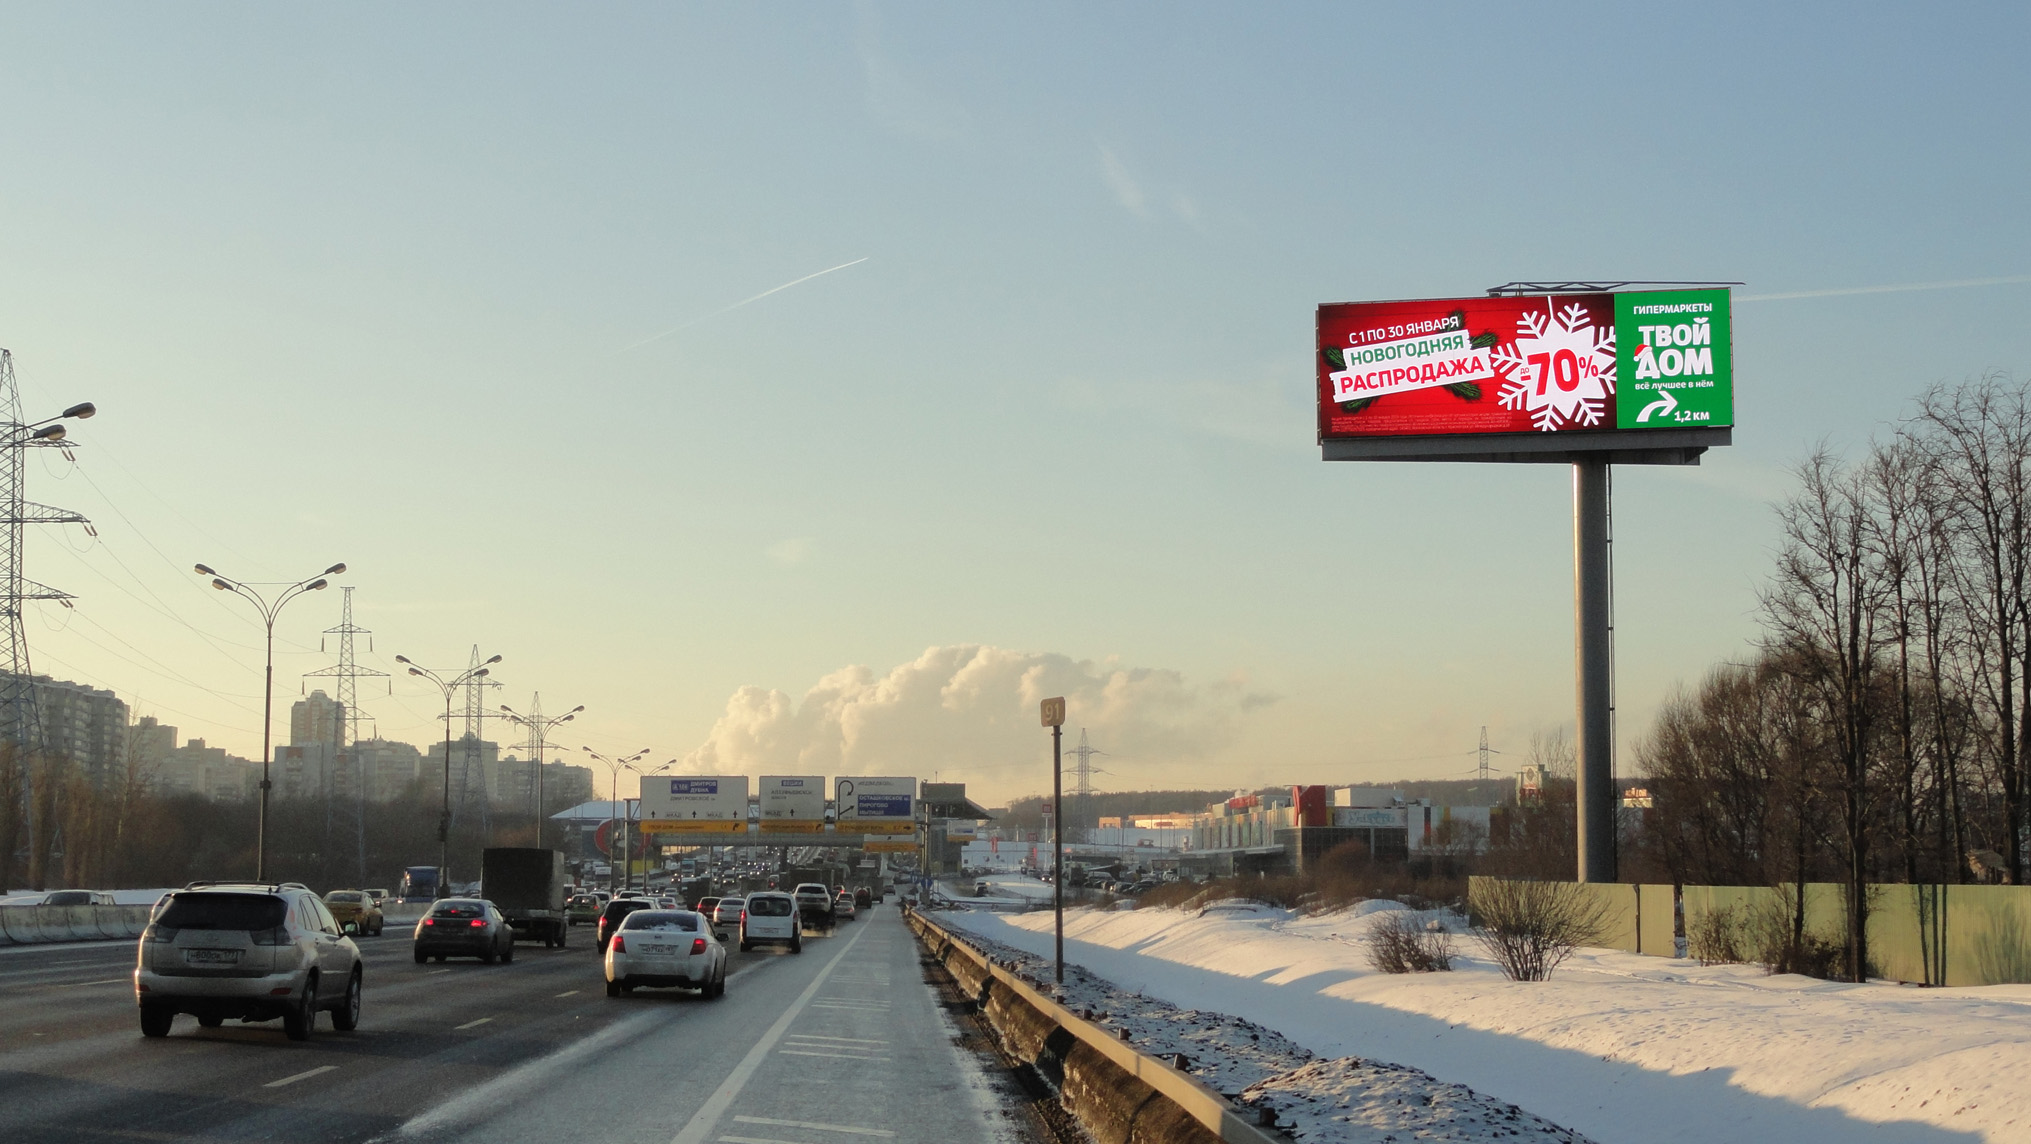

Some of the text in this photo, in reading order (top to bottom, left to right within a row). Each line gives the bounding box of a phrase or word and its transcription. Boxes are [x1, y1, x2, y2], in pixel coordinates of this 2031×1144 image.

[1633, 303, 1712, 314] ГИПЕРМАРКЕТЫ
[1349, 316, 1459, 345] С 1 ПО 30 ЯНВАРЯ
[1638, 317, 1711, 347] ТВОЙ
[1350, 335, 1465, 366] НОВОГОДНЯЯ
[1635, 347, 1713, 380] ДОМ
[1340, 356, 1485, 394] РАСПРОДАЖА
[1635, 382, 1650, 390] всё
[1652, 381, 1687, 391] лучшее
[1695, 379, 1714, 388] нём
[1674, 410, 1692, 423] 1,2
[1045, 703, 1060, 721] 91
